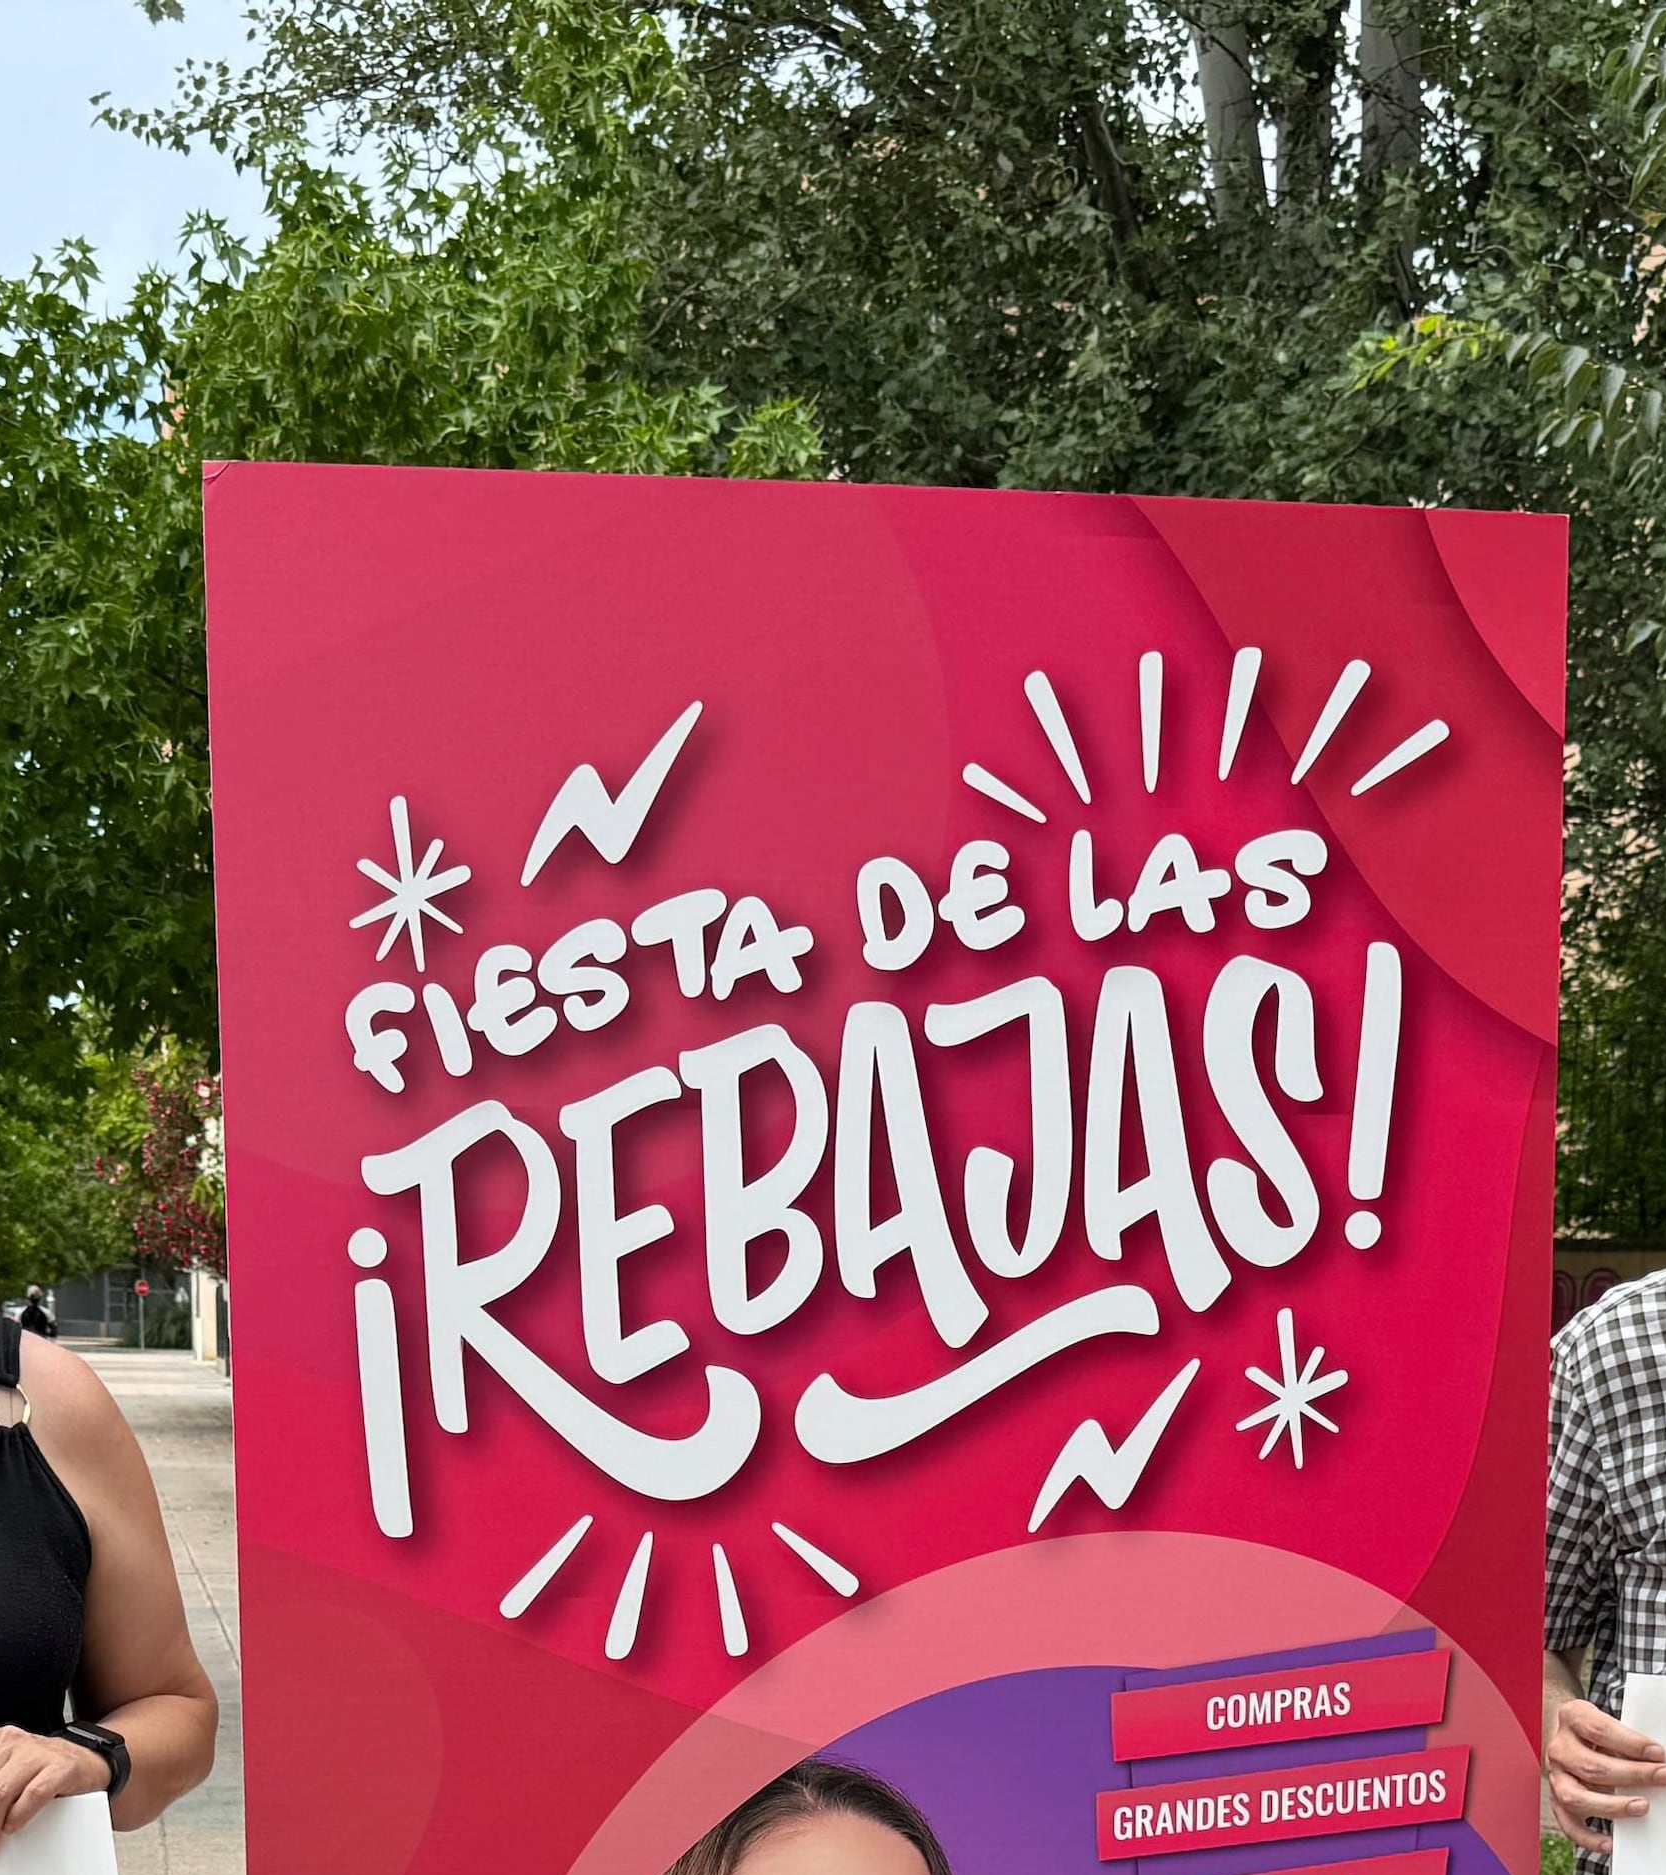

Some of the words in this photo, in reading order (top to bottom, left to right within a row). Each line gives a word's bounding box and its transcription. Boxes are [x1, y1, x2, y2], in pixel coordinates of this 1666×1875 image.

[345, 887, 815, 1094] FIESTA
[857, 840, 1026, 970] DE
[1068, 829, 1328, 942] LAS
[347, 942, 1402, 1539] ¡REBAJAS!
[1205, 1682, 1351, 1732] COMPRAS
[1113, 1792, 1250, 1842] GRANDES
[1261, 1768, 1448, 1824] DESCUENTOS
